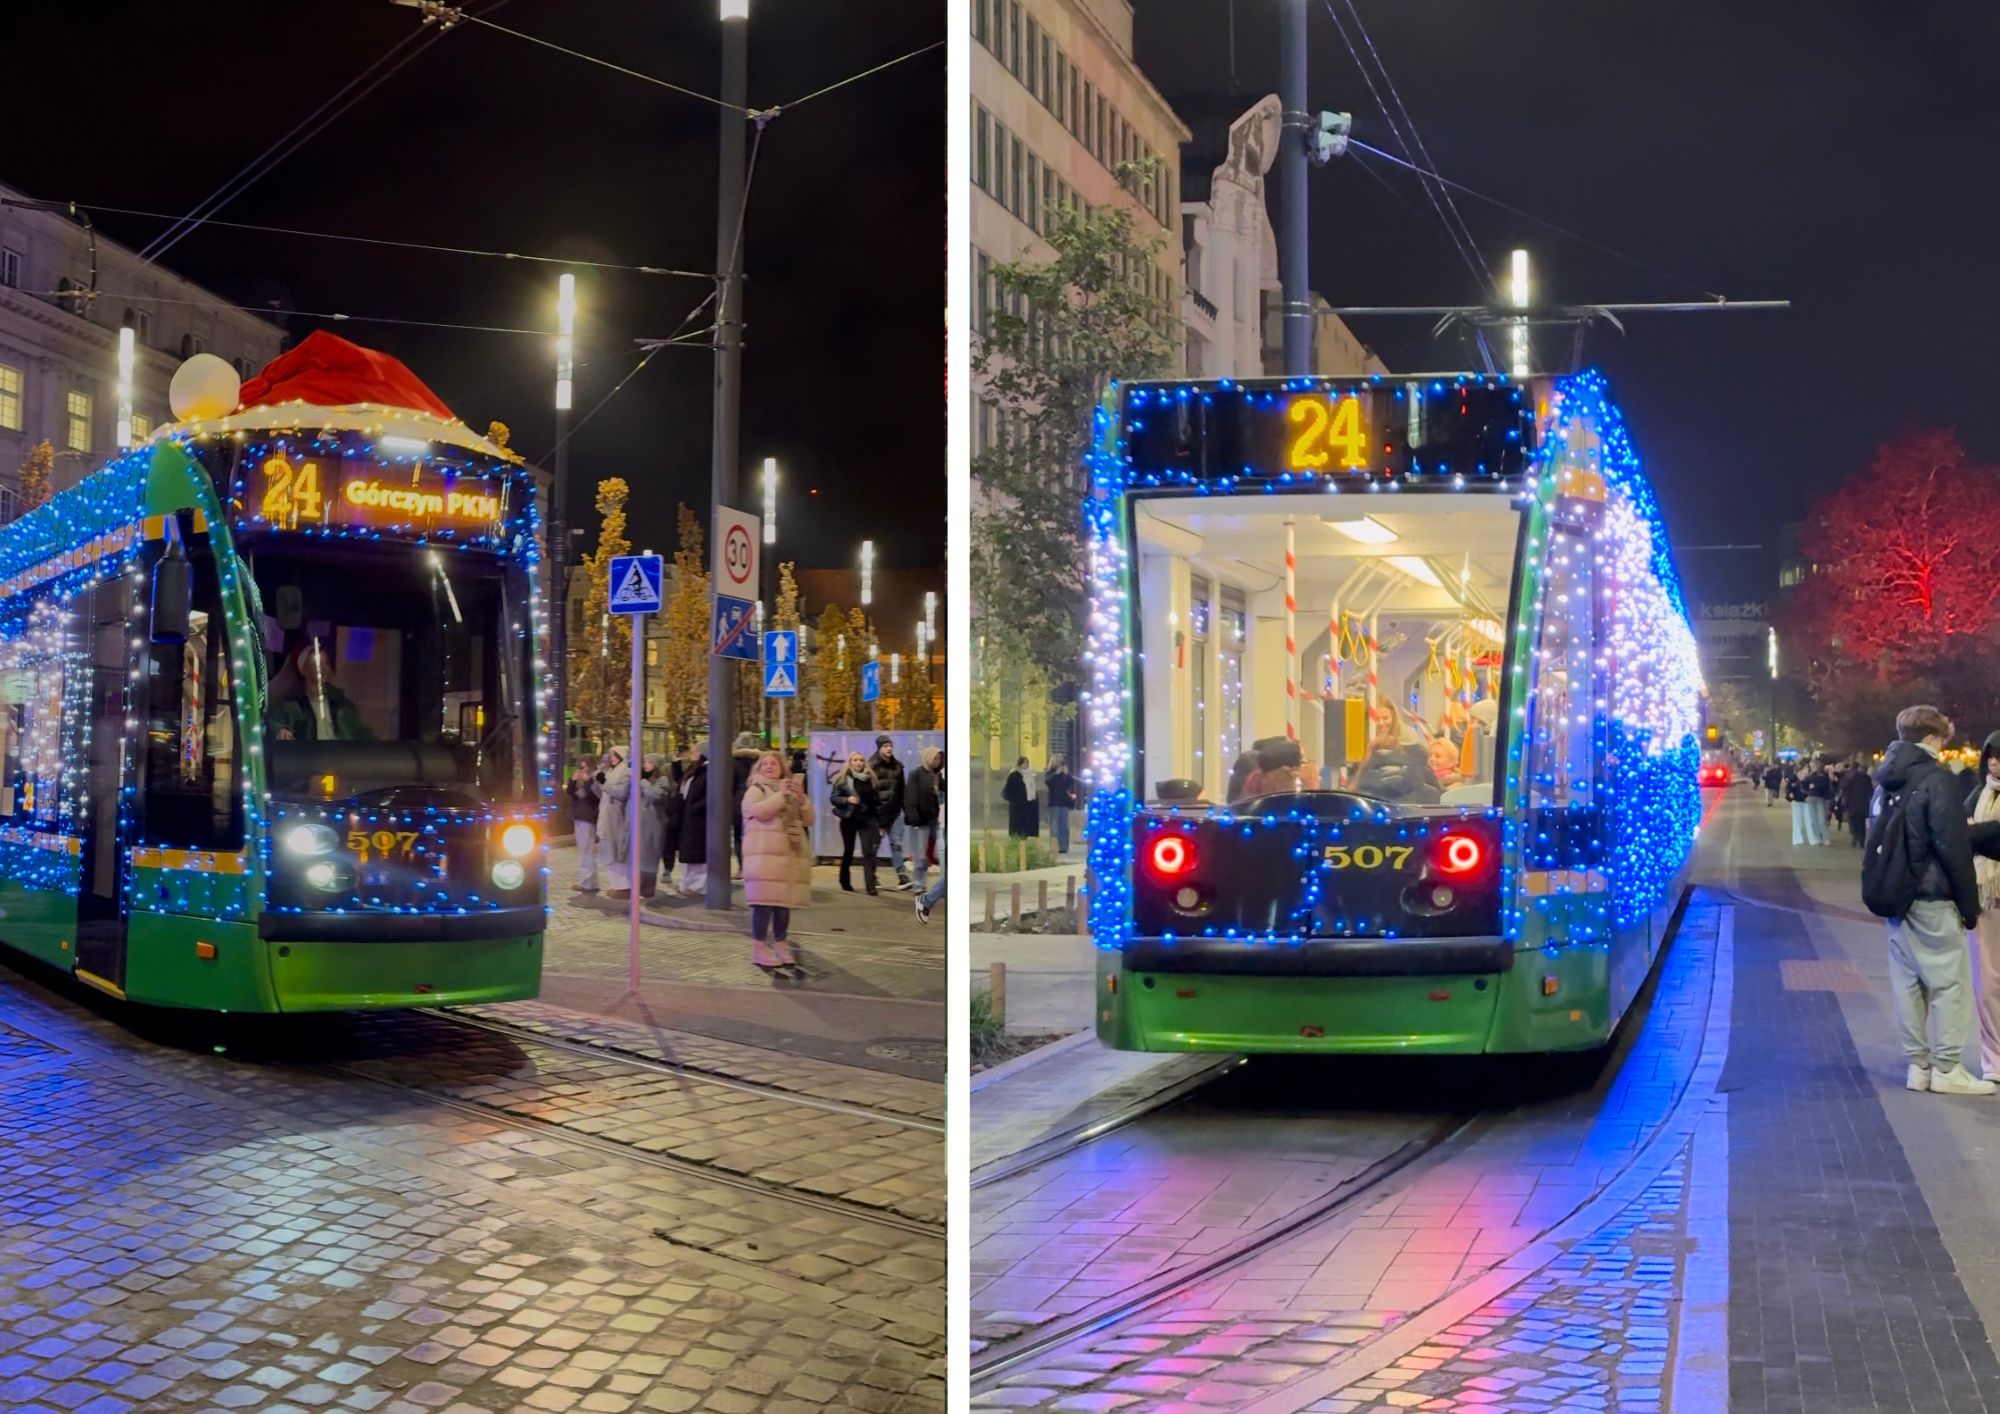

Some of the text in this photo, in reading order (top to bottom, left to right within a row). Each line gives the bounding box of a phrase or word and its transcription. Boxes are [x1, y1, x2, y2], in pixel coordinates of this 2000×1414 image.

[1291, 398, 1366, 467] 24
[263, 458, 321, 519] 24
[347, 480, 498, 519] Górczyn PKM
[728, 538, 748, 569] 30
[347, 831, 419, 851] 507
[1324, 845, 1414, 869] 507
